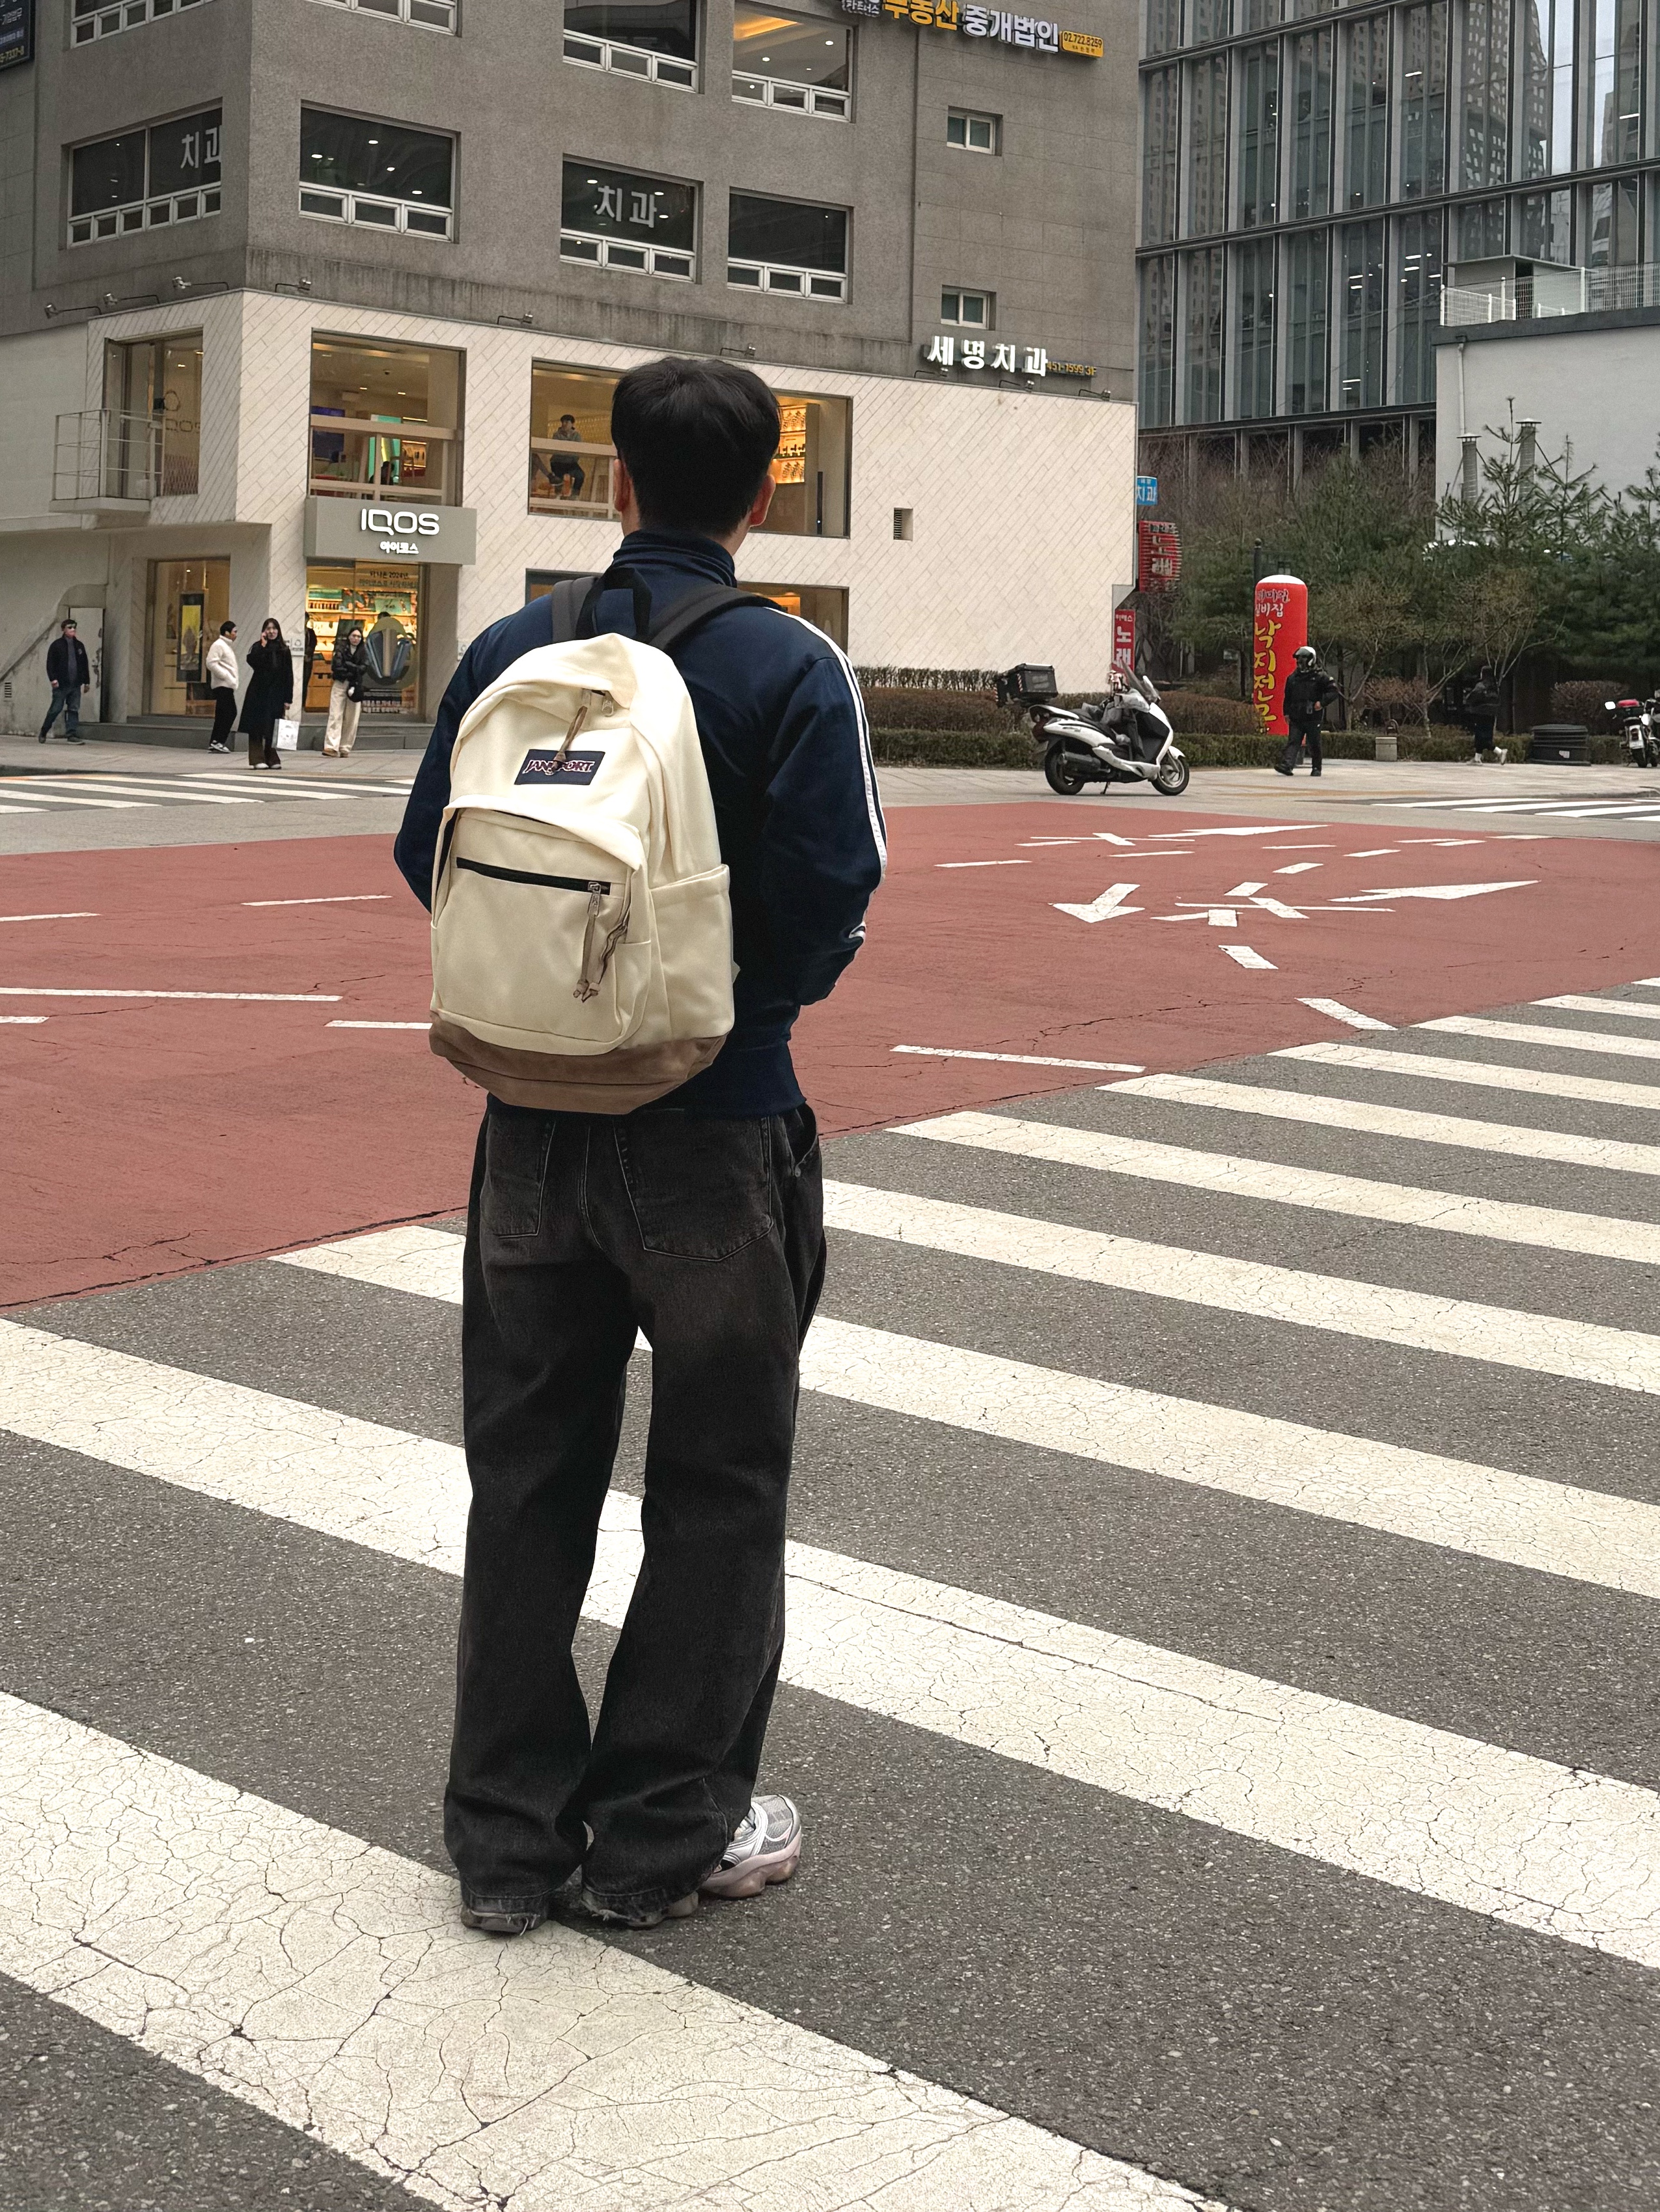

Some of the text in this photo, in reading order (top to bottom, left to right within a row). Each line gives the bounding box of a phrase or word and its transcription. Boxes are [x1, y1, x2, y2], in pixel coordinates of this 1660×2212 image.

[883, 0, 1059, 53] 부동산 중개법인
[180, 126, 222, 169] 치과
[596, 186, 657, 228] 치과
[927, 335, 1048, 377] 세명치과
[361, 508, 440, 536] IQOS
[380, 541, 419, 555] 아이코스
[522, 759, 596, 776] JANORT
